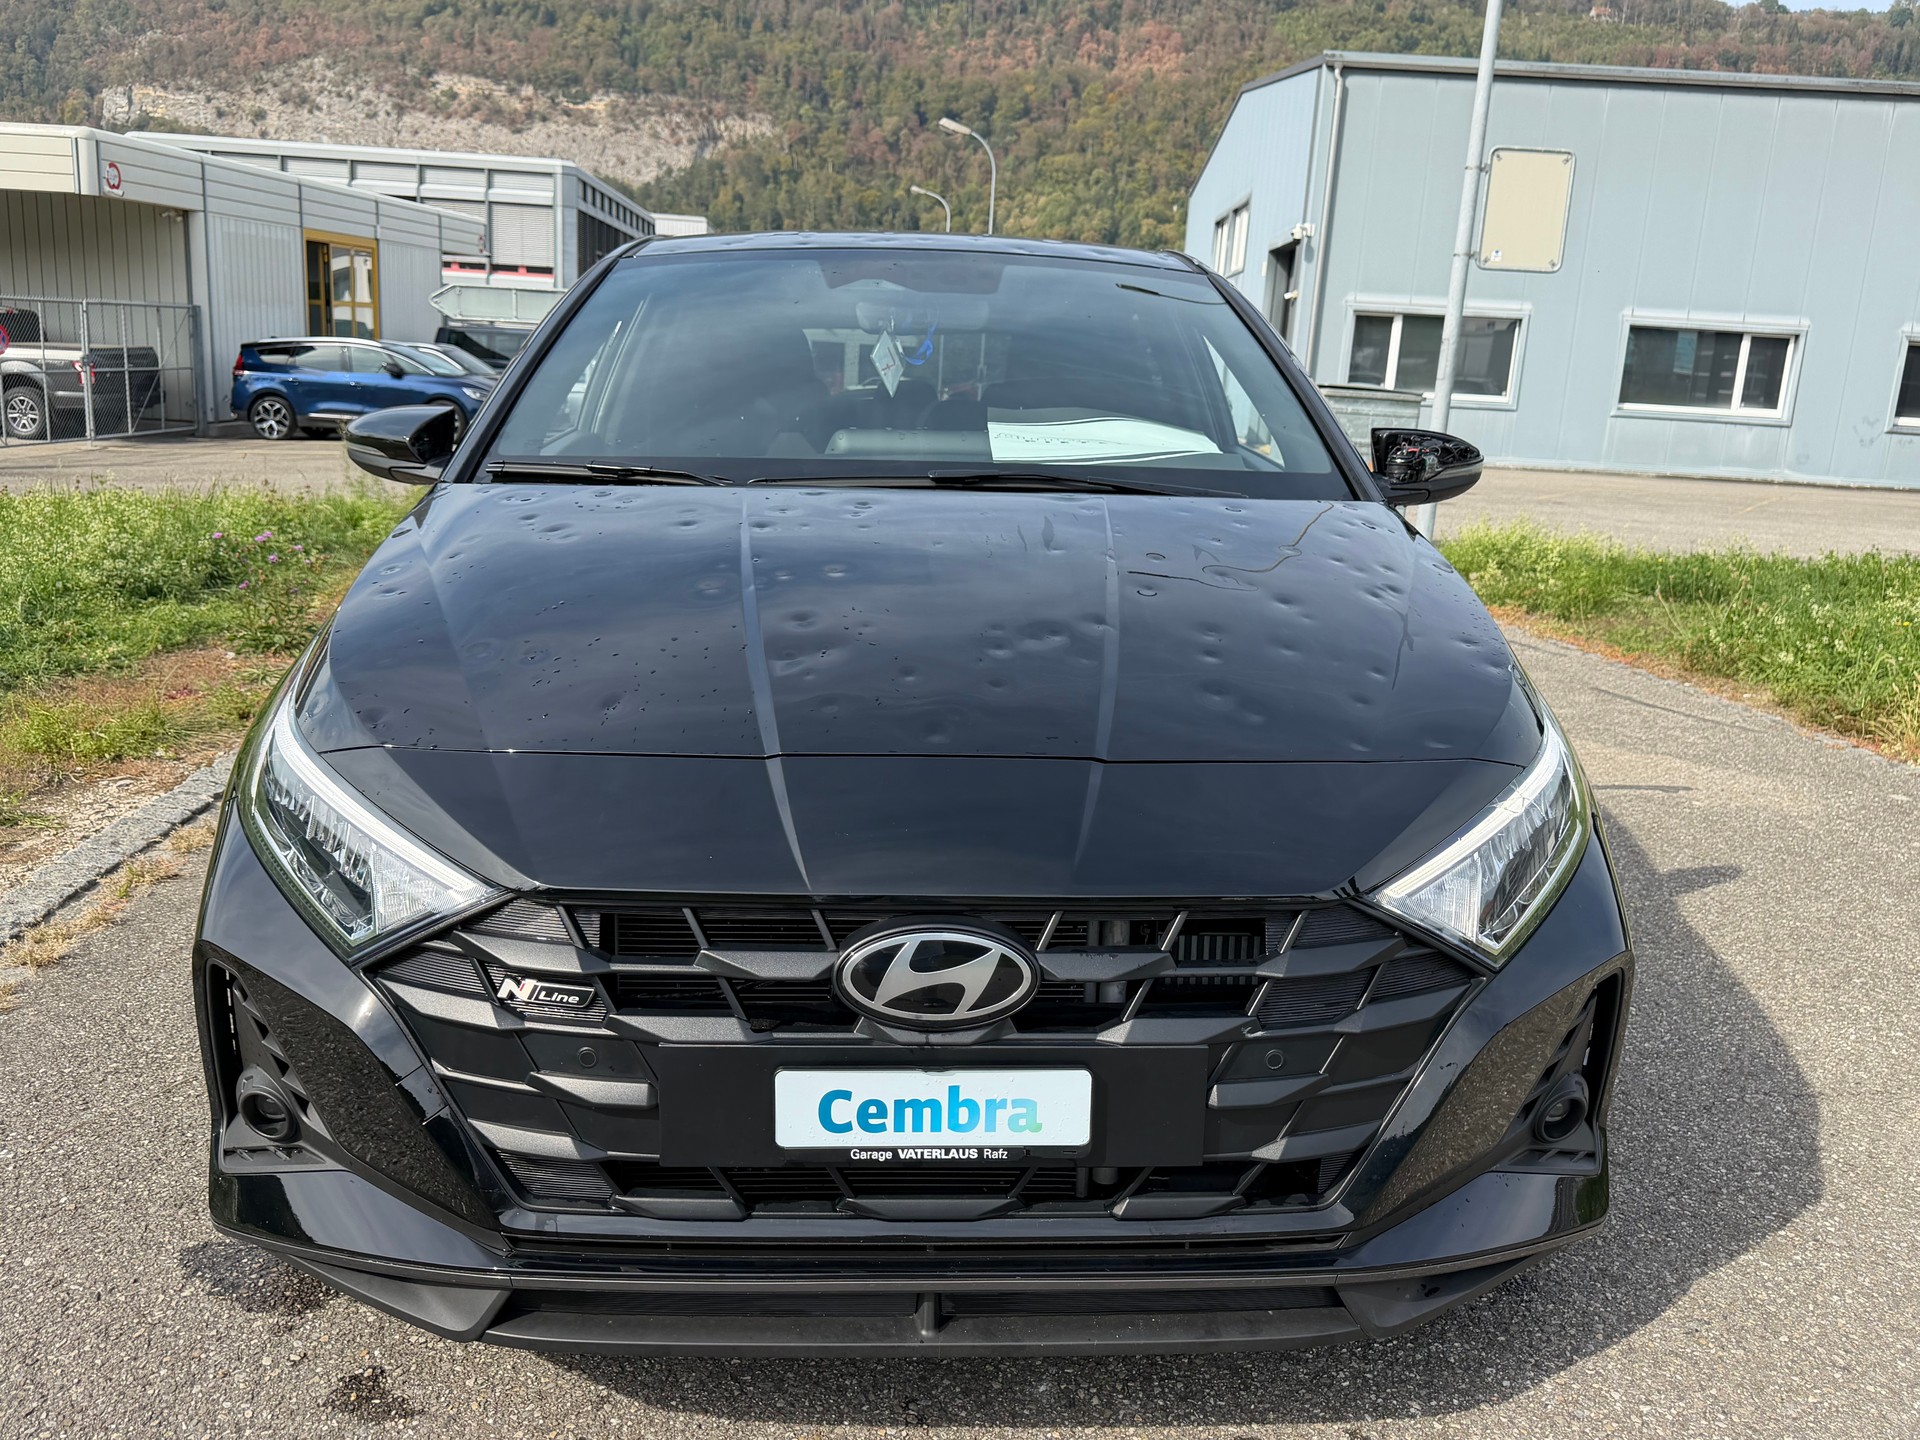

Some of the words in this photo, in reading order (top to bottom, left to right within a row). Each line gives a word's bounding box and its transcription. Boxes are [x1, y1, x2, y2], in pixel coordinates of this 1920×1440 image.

[497, 978, 536, 1001] N
[538, 991, 579, 1003] Line
[818, 1085, 1042, 1134] Cembra
[850, 1149, 893, 1161] Garage
[897, 1149, 979, 1159] VATERLAUS
[984, 1149, 1008, 1161] Rafz
